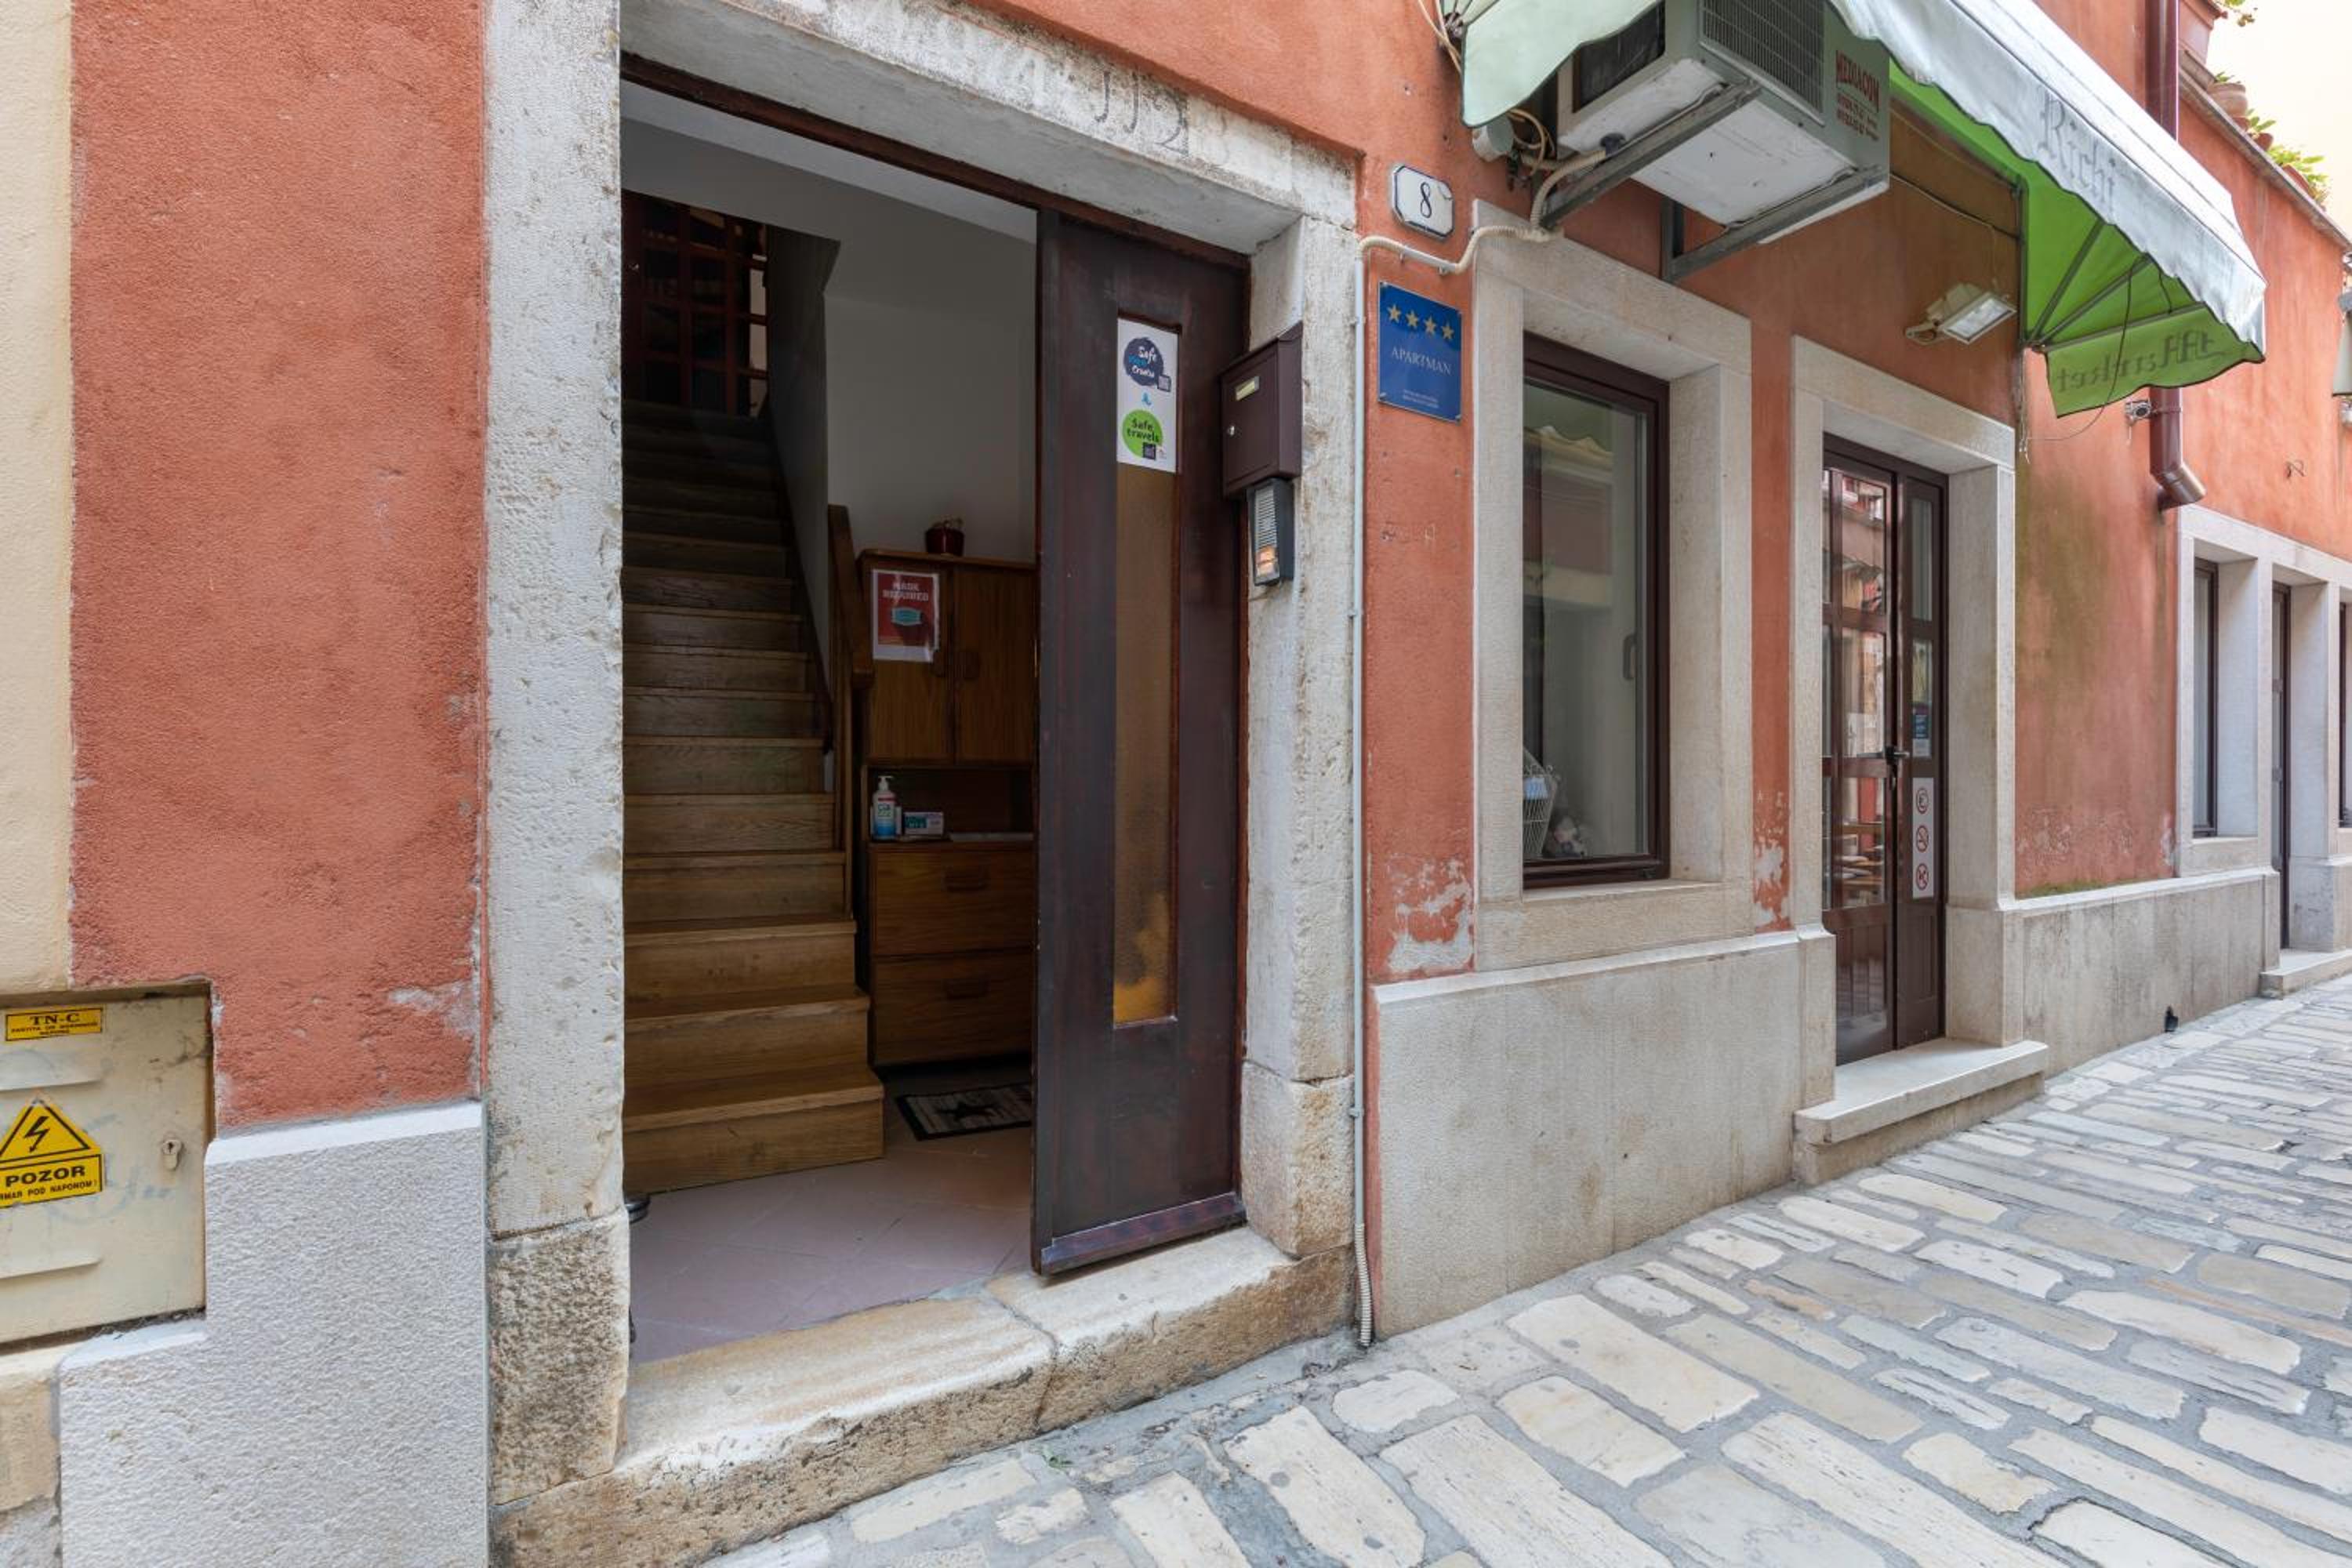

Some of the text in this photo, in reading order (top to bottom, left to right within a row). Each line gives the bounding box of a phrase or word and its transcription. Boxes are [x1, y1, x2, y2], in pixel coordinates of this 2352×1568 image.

[2038, 89, 2116, 216] Richi
[1420, 182, 1432, 219] 8
[1391, 347, 1452, 376] APARTMAN
[1131, 417, 1153, 432] Safe
[1127, 427, 1160, 443] travels
[892, 582, 920, 592] MASK
[30, 1012, 80, 1025] TN-C
[5, 1166, 85, 1188] POZOR
[27, 1187, 46, 1197] POD
